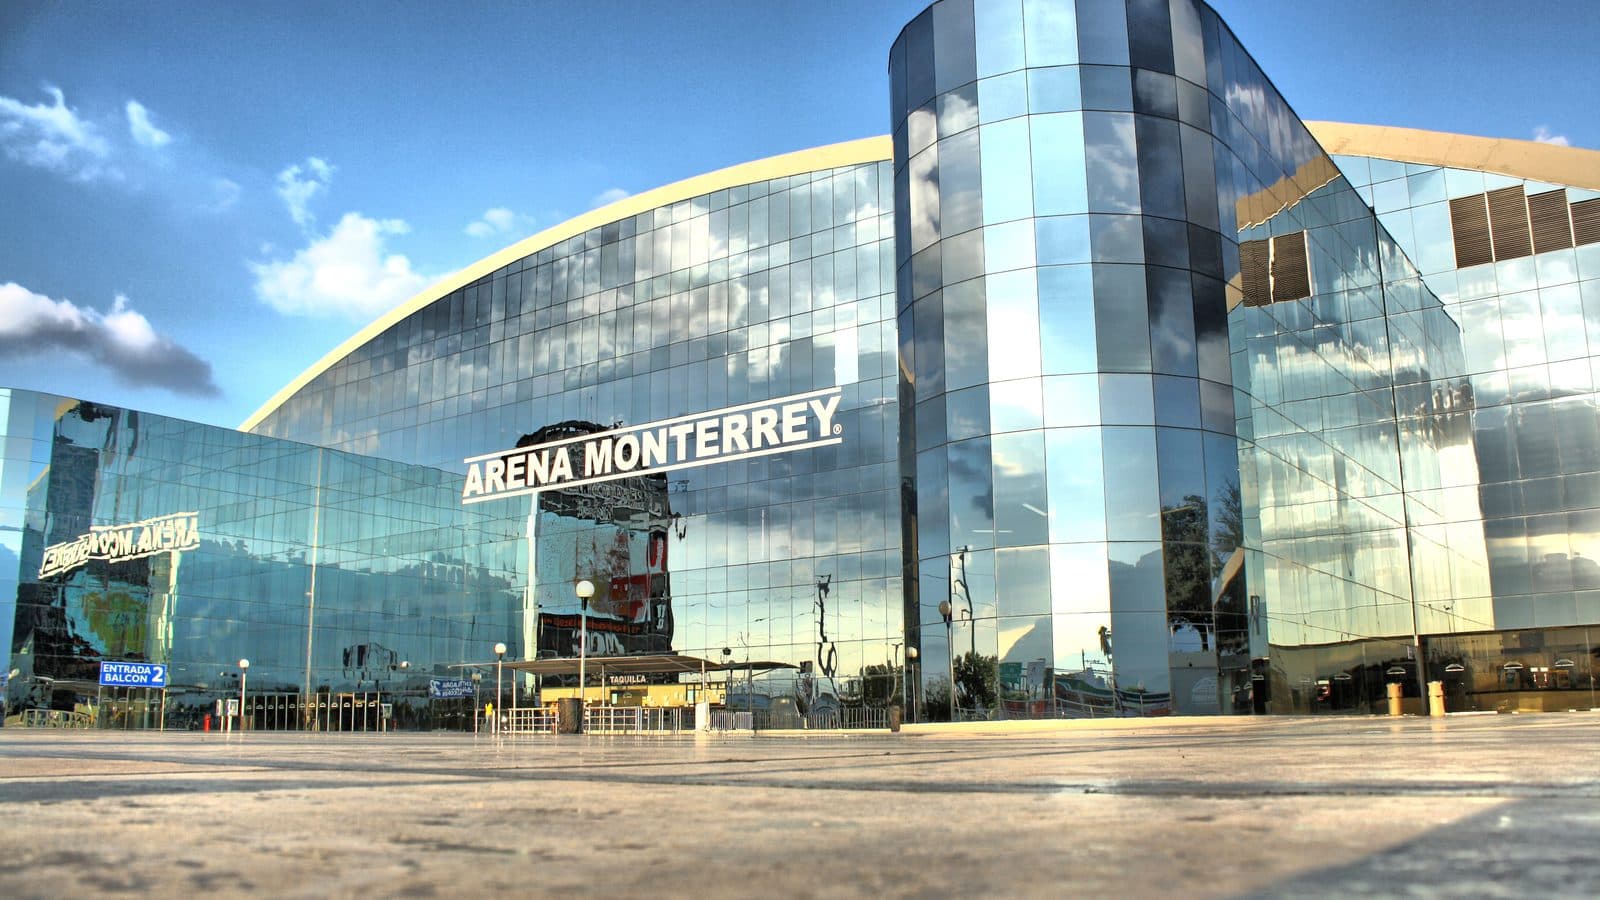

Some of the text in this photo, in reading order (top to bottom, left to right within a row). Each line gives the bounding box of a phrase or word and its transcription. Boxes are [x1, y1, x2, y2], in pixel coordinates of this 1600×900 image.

[462, 446, 574, 498] ARENA
[103, 664, 151, 674] ENTRADA
[105, 673, 148, 683] BALCON
[151, 666, 164, 683] 2
[609, 674, 647, 684] TAQUILLA
